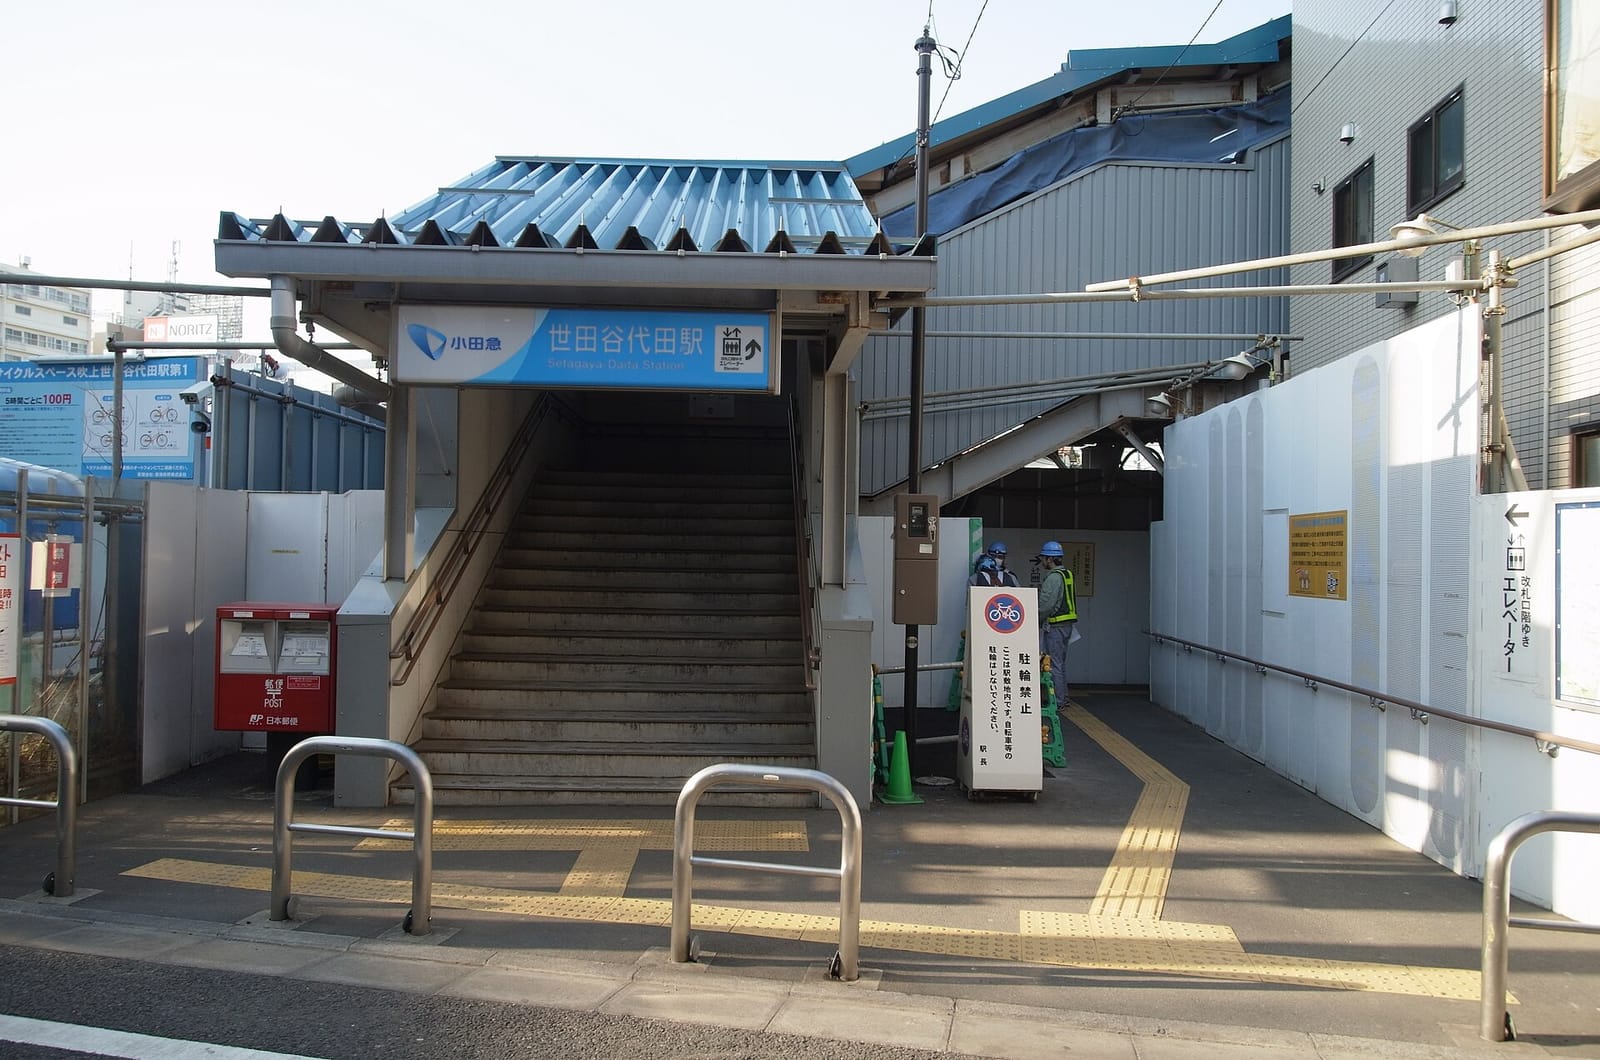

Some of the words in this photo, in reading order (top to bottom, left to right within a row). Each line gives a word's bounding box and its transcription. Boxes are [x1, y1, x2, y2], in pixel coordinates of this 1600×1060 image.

[169, 323, 213, 337] NORITZ
[549, 324, 704, 355] 世田谷代田駅
[450, 336, 502, 351] 小田急
[1520, 575, 1531, 648] 改札口階ゆき
[1502, 577, 1517, 673] エレベーター
[264, 679, 284, 690] 郵便
[988, 646, 999, 733] 駐輪はしないでください。
[1018, 653, 1032, 714] 駐輪禁止
[264, 699, 283, 708] POST
[266, 716, 299, 726] 日本郵便
